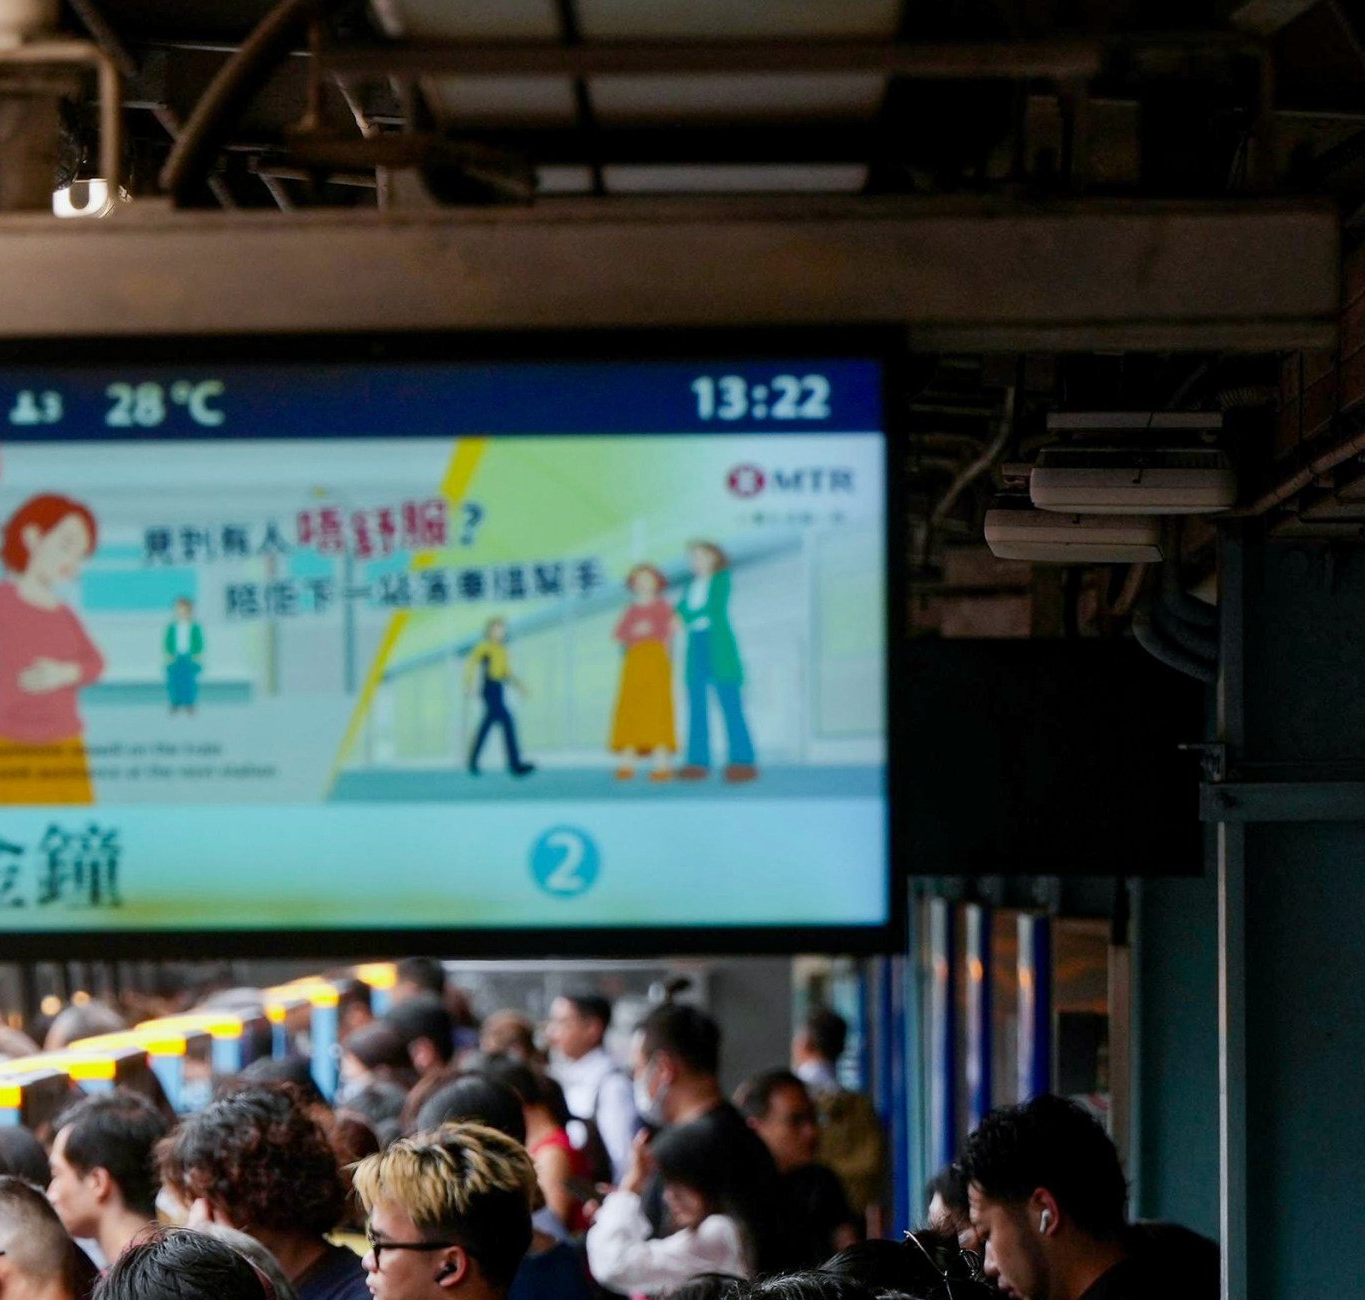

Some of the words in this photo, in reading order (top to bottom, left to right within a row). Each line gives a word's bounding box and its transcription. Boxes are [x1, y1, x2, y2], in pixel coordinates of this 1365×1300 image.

[105, 379, 225, 427] 28°C
[691, 373, 831, 421] 13:22
[774, 467, 856, 493] MTR
[546, 835, 584, 892] 2
